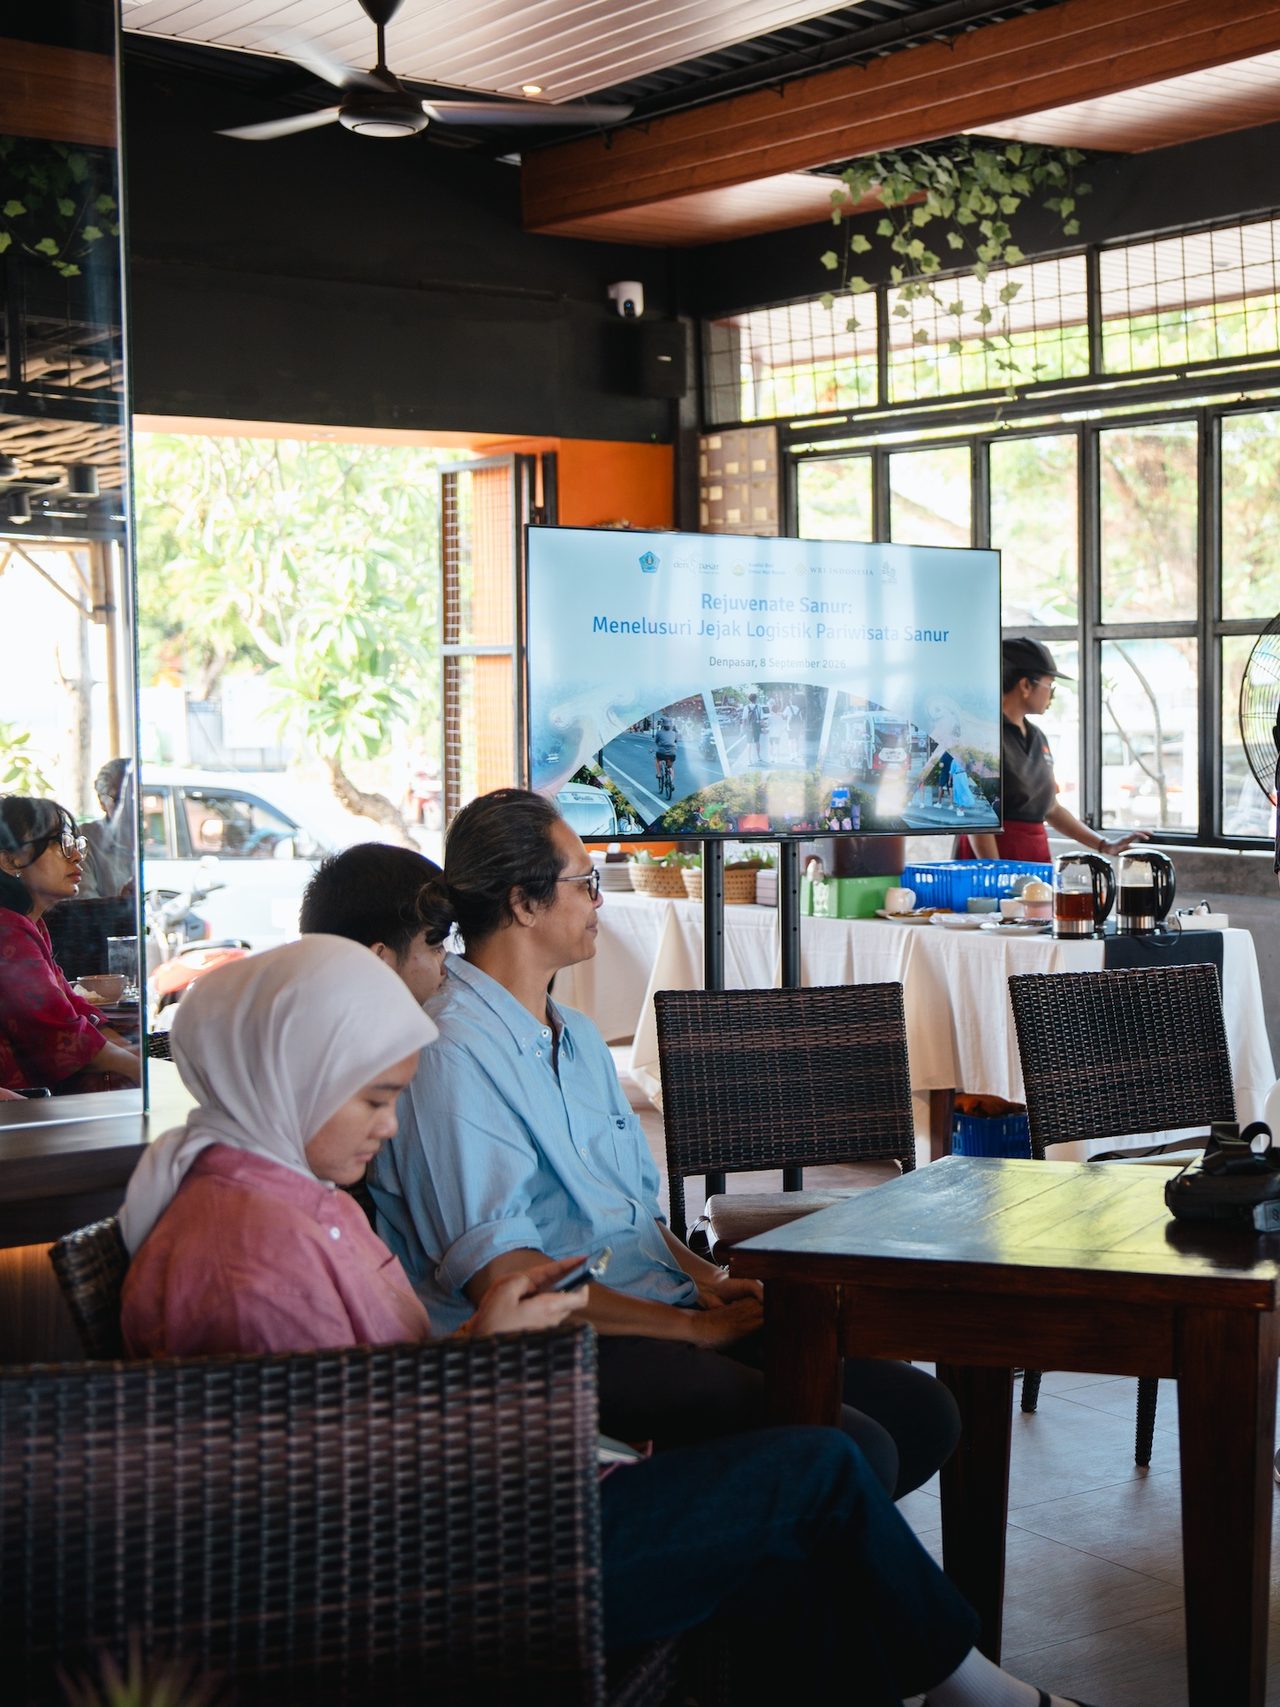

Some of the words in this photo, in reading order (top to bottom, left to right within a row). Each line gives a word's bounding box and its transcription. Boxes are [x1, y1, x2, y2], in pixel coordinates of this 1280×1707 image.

[829, 567, 874, 576] INDONESIA
[701, 593, 795, 615] Rejuvenate
[799, 597, 853, 615] Sanur:
[592, 616, 692, 636] Menelusuri
[697, 619, 742, 638] Jejak
[746, 621, 812, 641] Logistik
[816, 624, 899, 641] Pariwisata
[904, 626, 949, 643] Sanur
[709, 656, 758, 669] Denpasar,
[760, 657, 766, 667] 8
[768, 657, 820, 670] September
